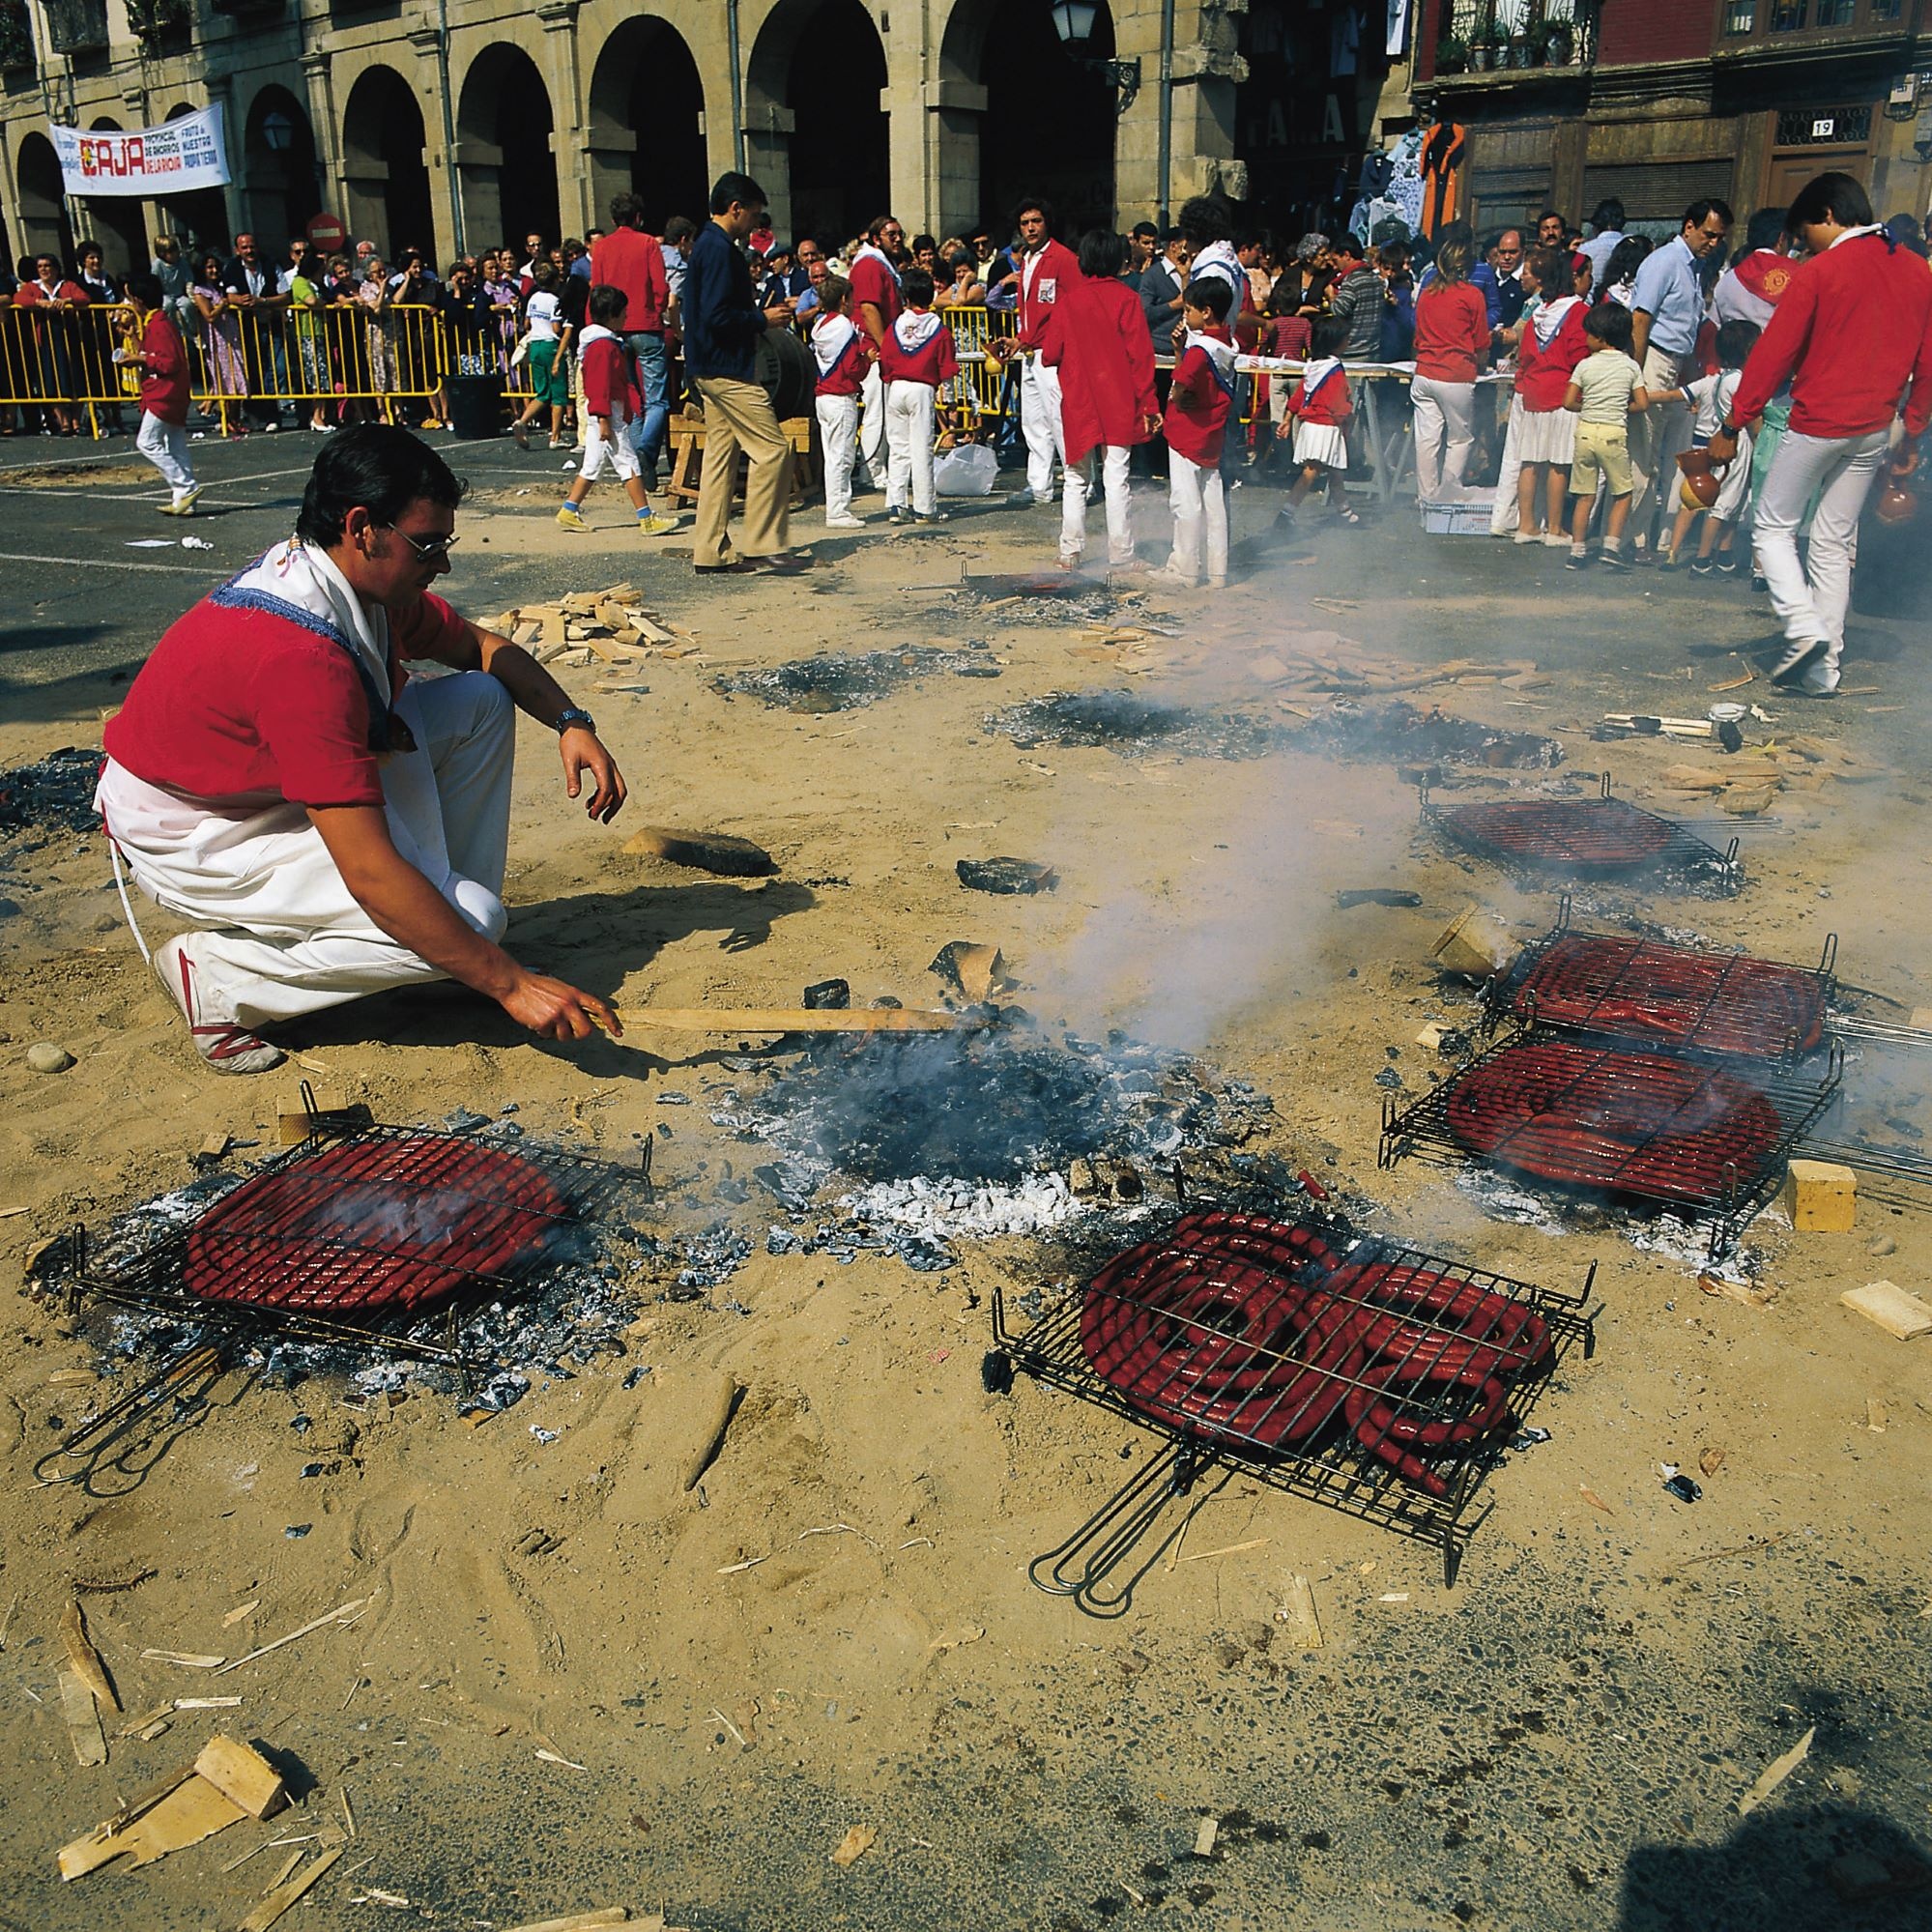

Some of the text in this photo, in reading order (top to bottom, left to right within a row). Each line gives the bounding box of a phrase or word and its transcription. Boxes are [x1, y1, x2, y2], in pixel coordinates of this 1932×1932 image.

[1816, 122, 1831, 134] 19
[80, 137, 145, 176] CAJA
[145, 142, 179, 157] DE AHORROS
